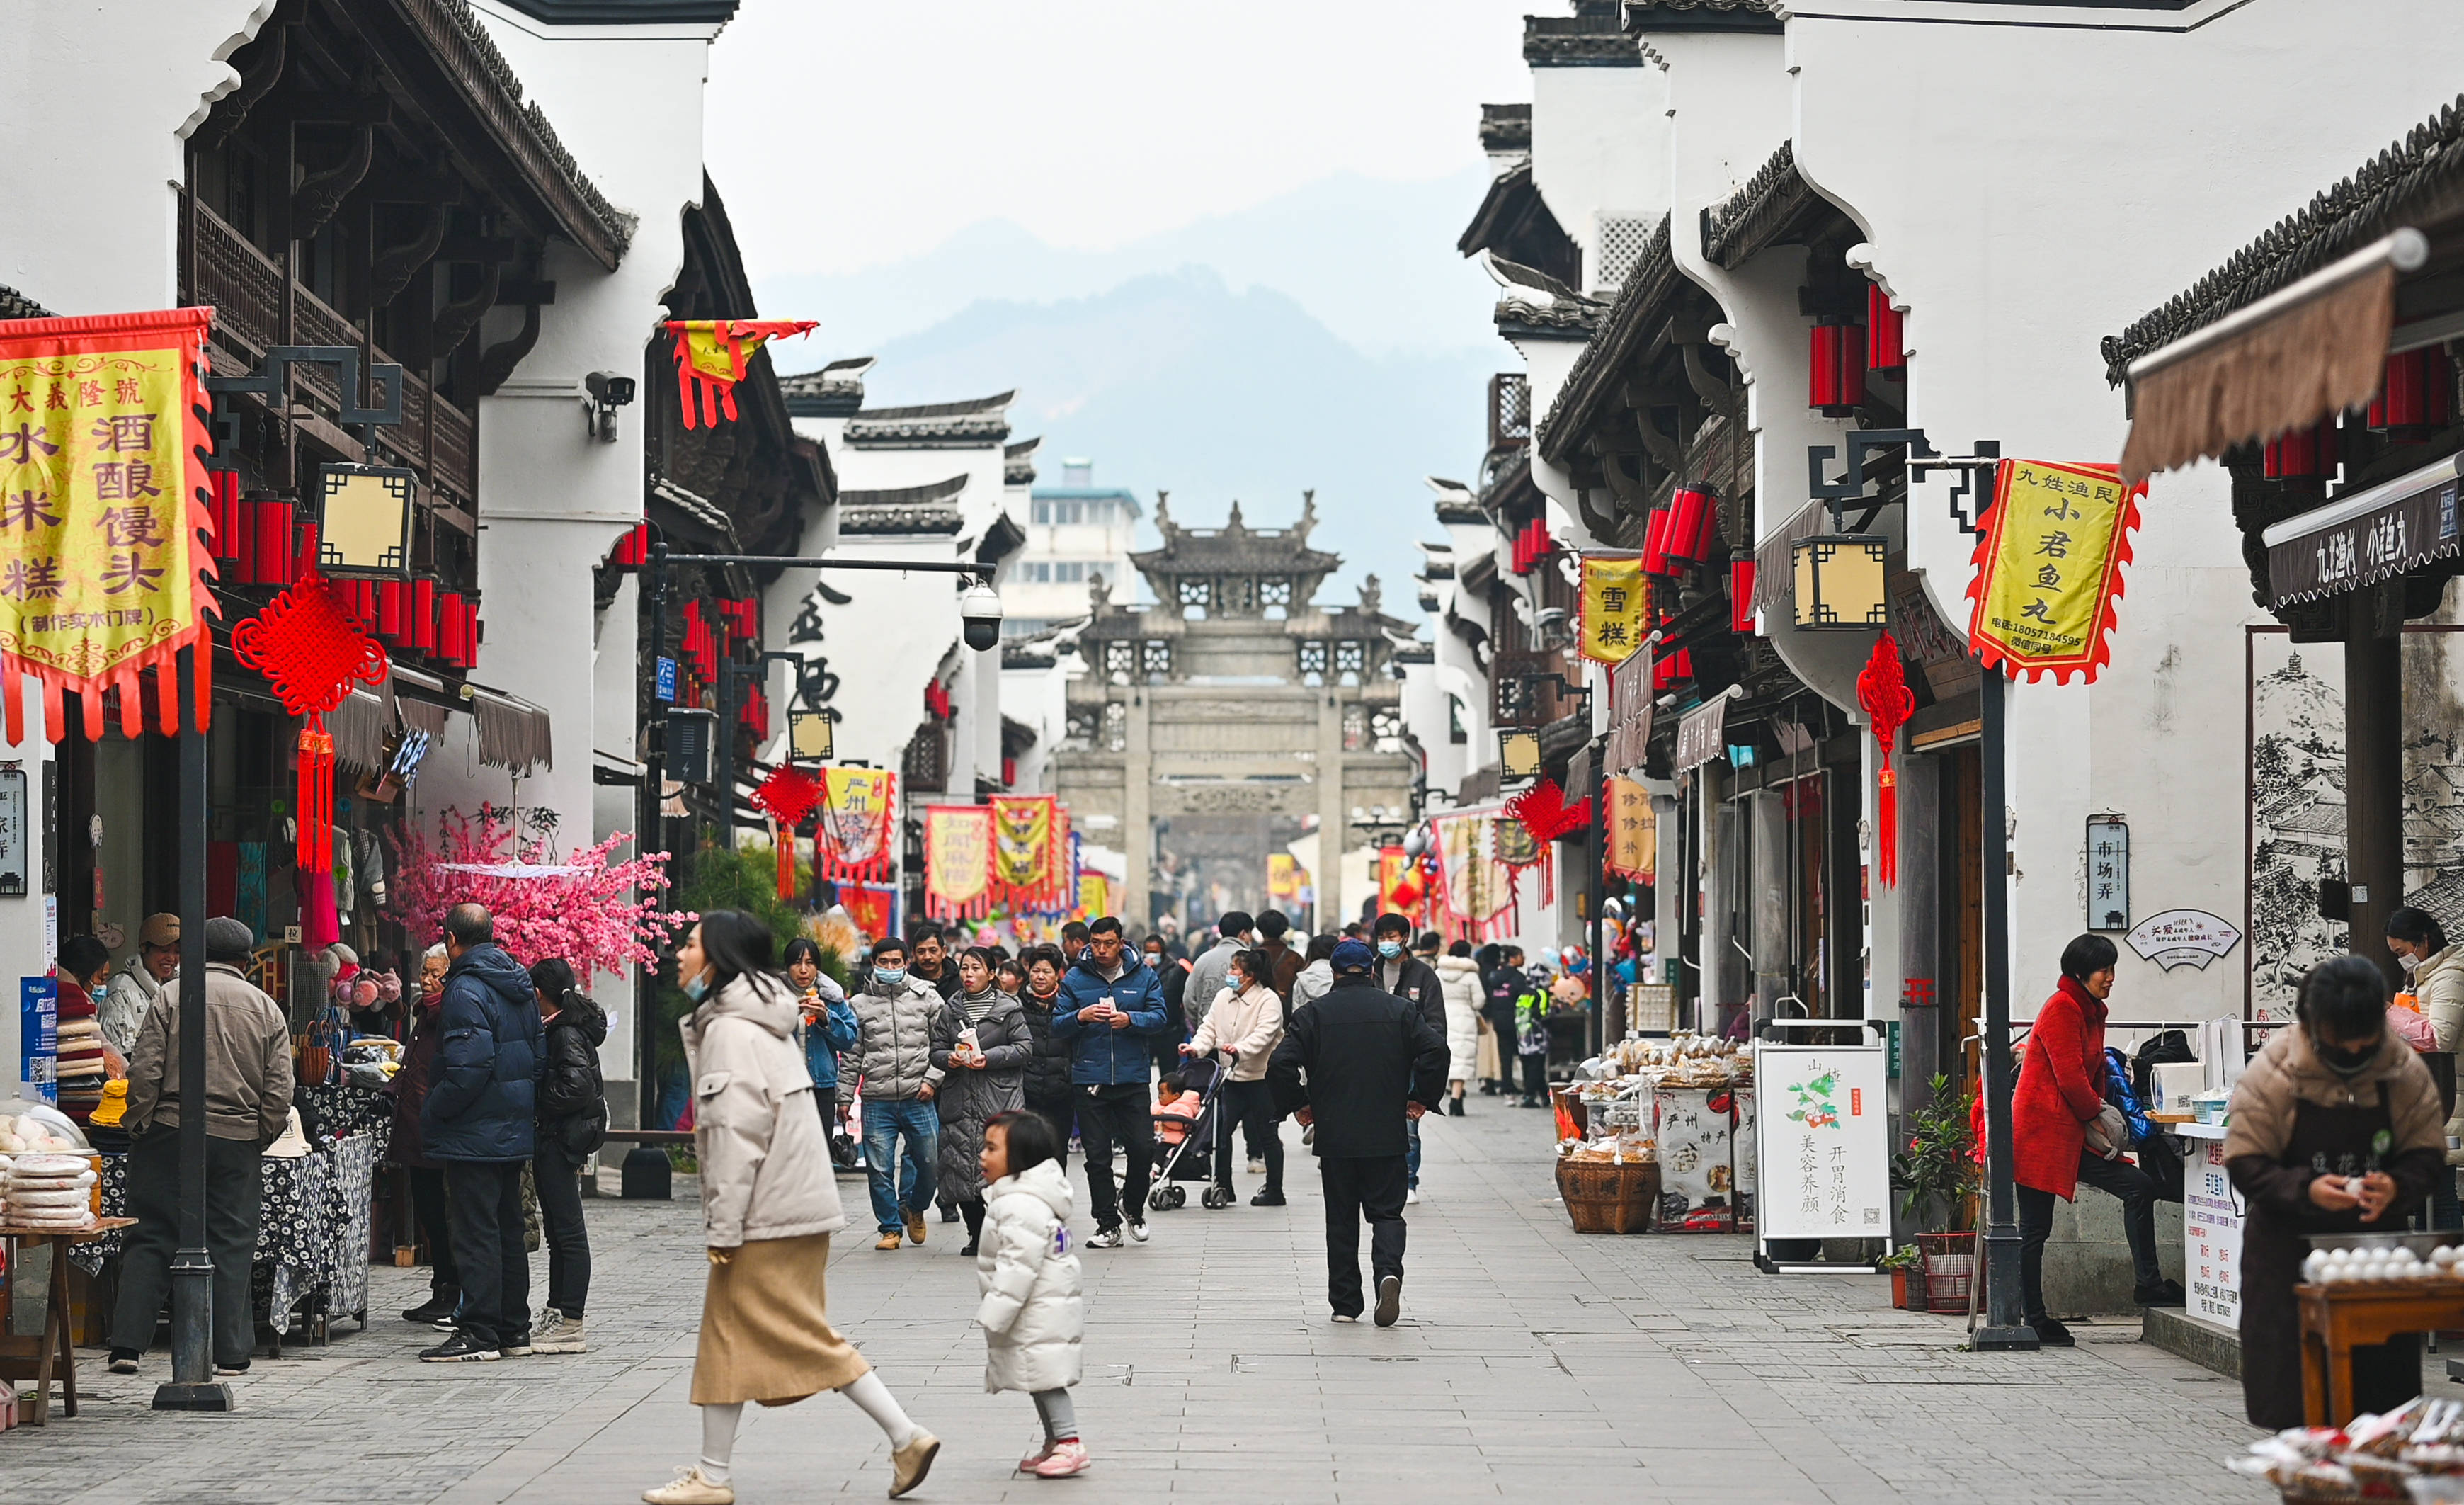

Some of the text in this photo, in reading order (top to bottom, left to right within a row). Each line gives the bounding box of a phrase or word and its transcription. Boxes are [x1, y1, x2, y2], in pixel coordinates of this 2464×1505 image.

[10, 377, 144, 414] 大義隆號
[0, 422, 66, 601] 水米糕
[91, 413, 165, 595] 酒酿馒头
[2016, 468, 2115, 504] 九姓渔民
[2019, 497, 2080, 625] 小君鱼丸
[2366, 511, 2407, 566] 小君鱼丸
[1597, 586, 1629, 646] 雪糕
[2010, 635, 2052, 654] 微信同号
[2097, 841, 2114, 901] 市场弄
[1667, 1111, 1699, 1130] 严州
[1701, 1130, 1726, 1145] 特产
[1799, 1134, 1820, 1213] 美容养颜
[1828, 1146, 1849, 1225] 开胃消食
